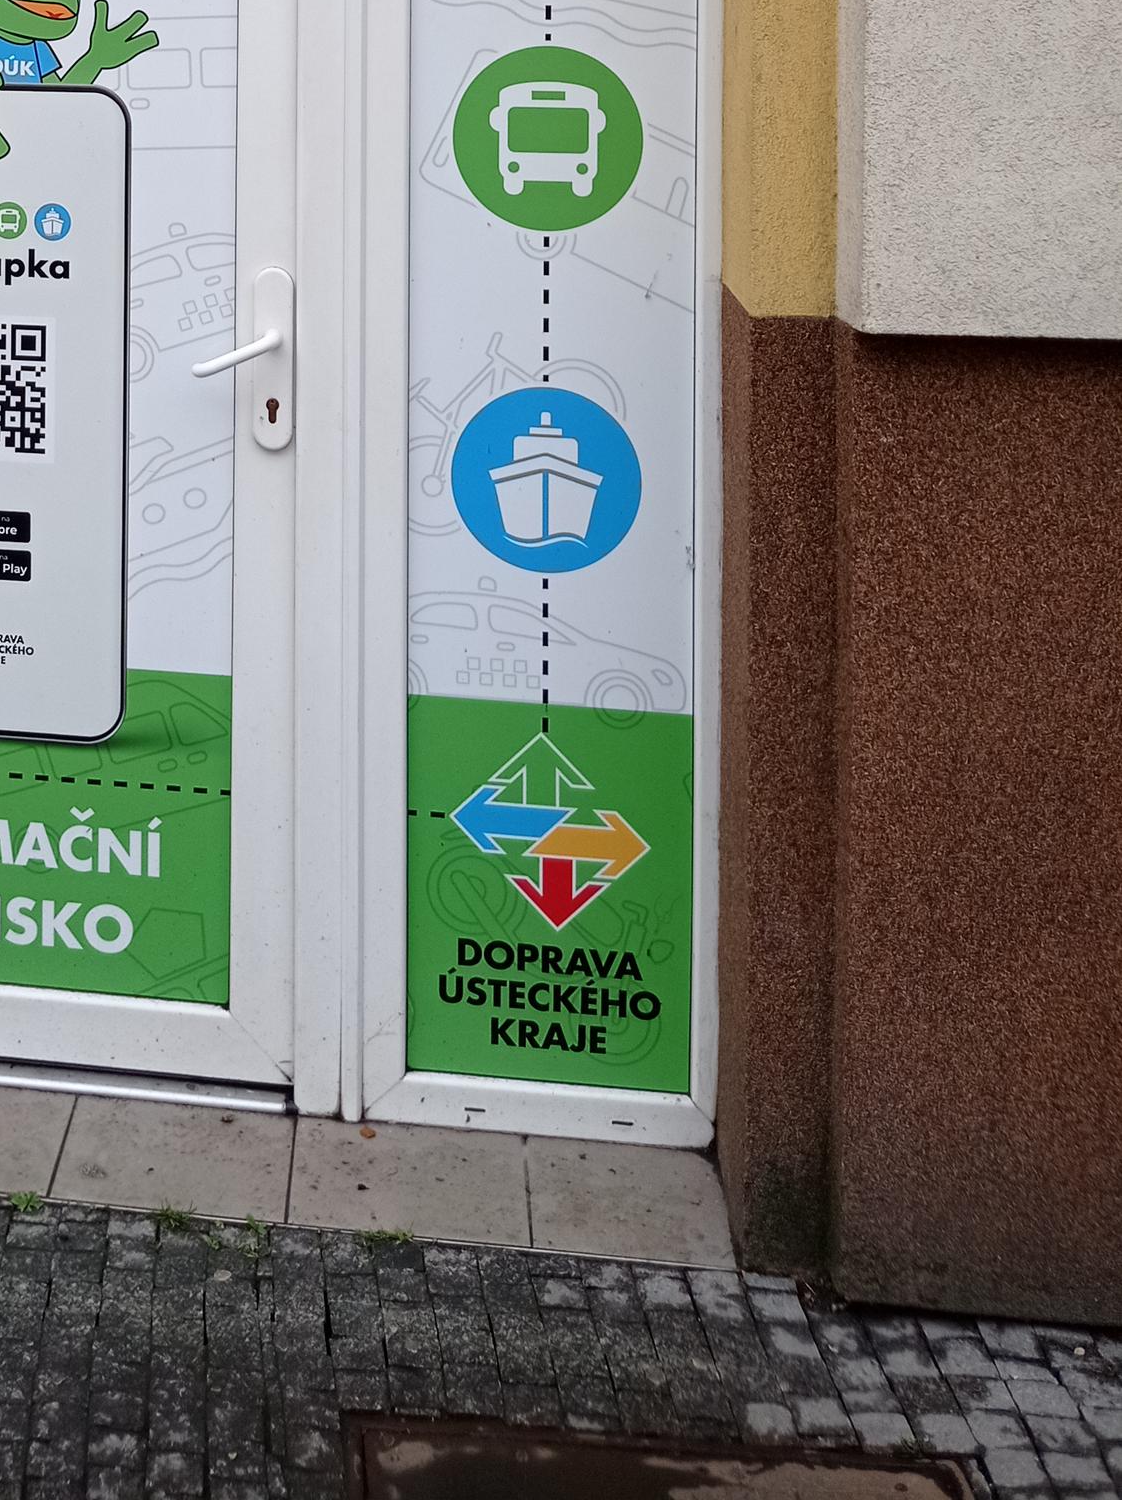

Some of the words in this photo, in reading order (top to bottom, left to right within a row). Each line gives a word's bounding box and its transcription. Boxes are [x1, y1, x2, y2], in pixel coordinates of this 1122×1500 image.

[3, 563, 27, 576] Play
[458, 938, 643, 981] DOPRAVA
[439, 967, 661, 1020] ÚSTECKÉHO
[491, 1017, 606, 1054] KRAJE
